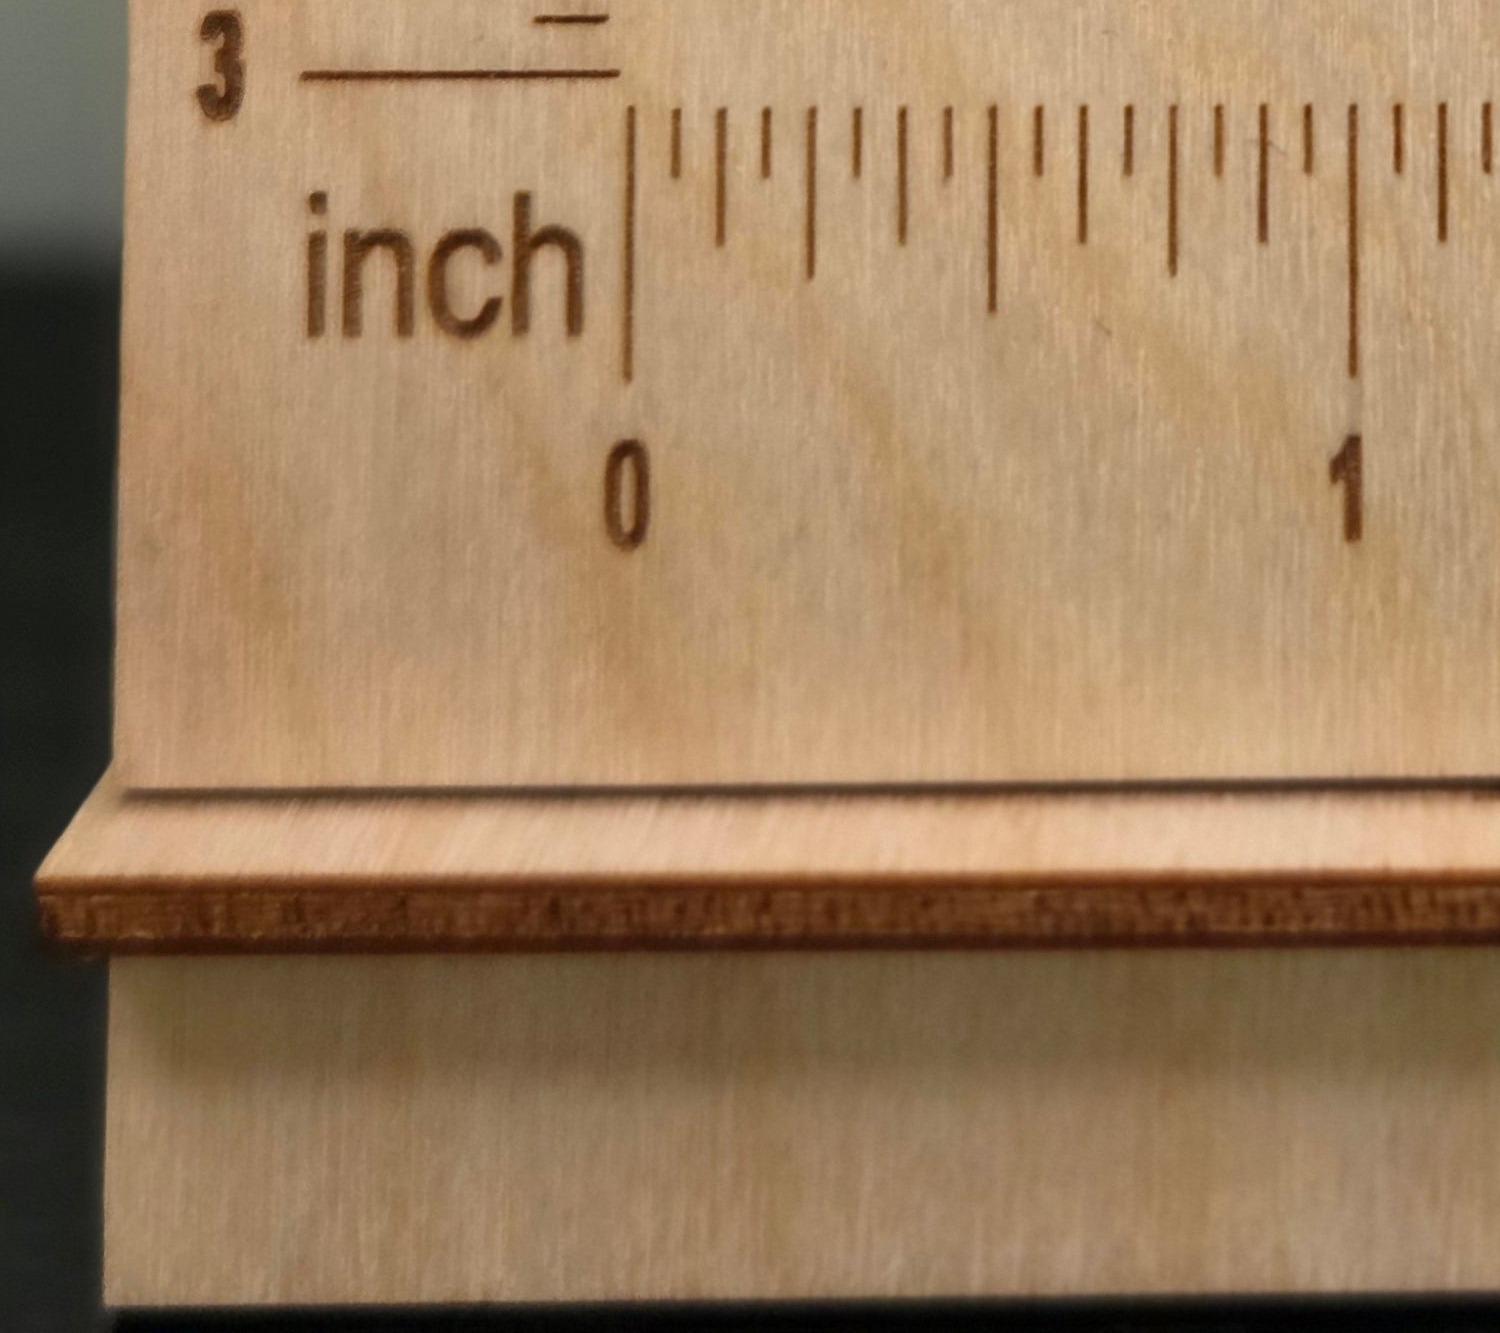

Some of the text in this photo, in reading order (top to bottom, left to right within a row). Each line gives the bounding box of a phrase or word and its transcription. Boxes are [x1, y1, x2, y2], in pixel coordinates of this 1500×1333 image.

[193, 8, 246, 124] 3
[305, 189, 586, 344] inch
[601, 437, 652, 554] 0
[1327, 431, 1364, 545] 1
